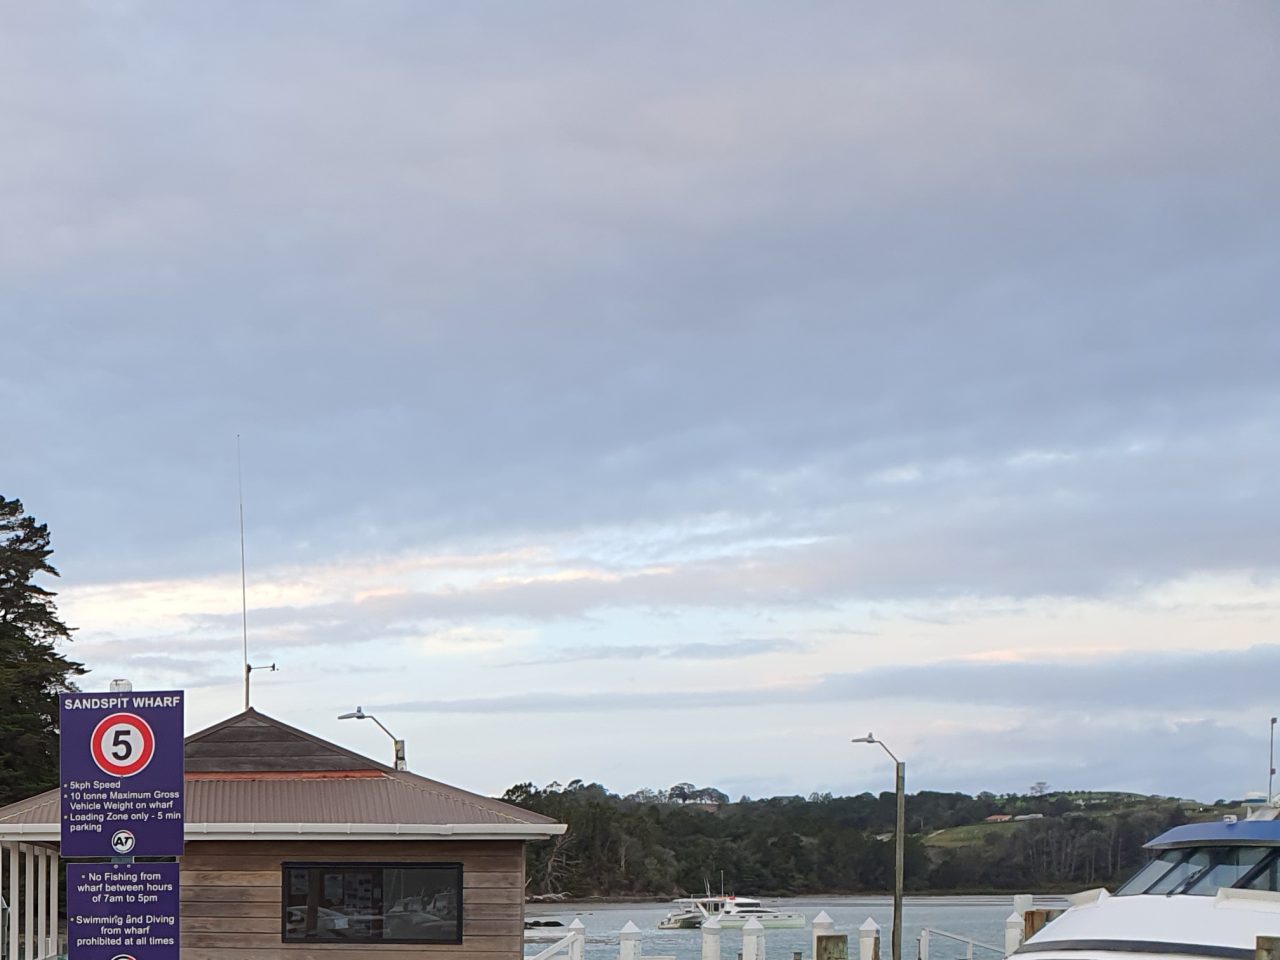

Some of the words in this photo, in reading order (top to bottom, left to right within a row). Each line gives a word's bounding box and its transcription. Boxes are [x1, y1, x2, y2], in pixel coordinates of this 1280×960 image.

[64, 698, 129, 710] SANDSPIT
[133, 696, 181, 708] WHARF
[111, 730, 132, 761] 5
[70, 781, 91, 791] 5kph
[93, 780, 121, 790] Speed
[70, 792, 81, 800] 10
[83, 792, 107, 800] tonne
[109, 791, 151, 799] Maximum
[153, 790, 180, 799] Gross
[70, 802, 101, 810] Vehicle
[103, 801, 133, 811] Weight
[149, 800, 174, 809] wharf
[70, 813, 104, 822] Loading
[106, 812, 129, 820] Zone
[130, 812, 149, 821] only
[157, 812, 163, 820] 5
[165, 811, 181, 819] min
[70, 823, 102, 832] parking
[113, 836, 133, 847] AT
[88, 872, 102, 881] No
[104, 872, 138, 882] Fishing
[140, 872, 161, 880] from
[77, 883, 103, 892] wharf
[105, 883, 144, 891] between
[146, 883, 173, 891] hours
[92, 894, 101, 903] of
[104, 894, 124, 902] 7am
[126, 894, 135, 902] to
[137, 893, 158, 904] 5pm
[76, 915, 123, 925] Swimming
[126, 915, 143, 923] and
[145, 915, 175, 925] Diving
[100, 926, 121, 934] from
[124, 926, 150, 934] wharf
[76, 937, 122, 947] prohibited
[124, 937, 134, 945] at
[135, 937, 147, 945] all
[149, 936, 174, 945] times
